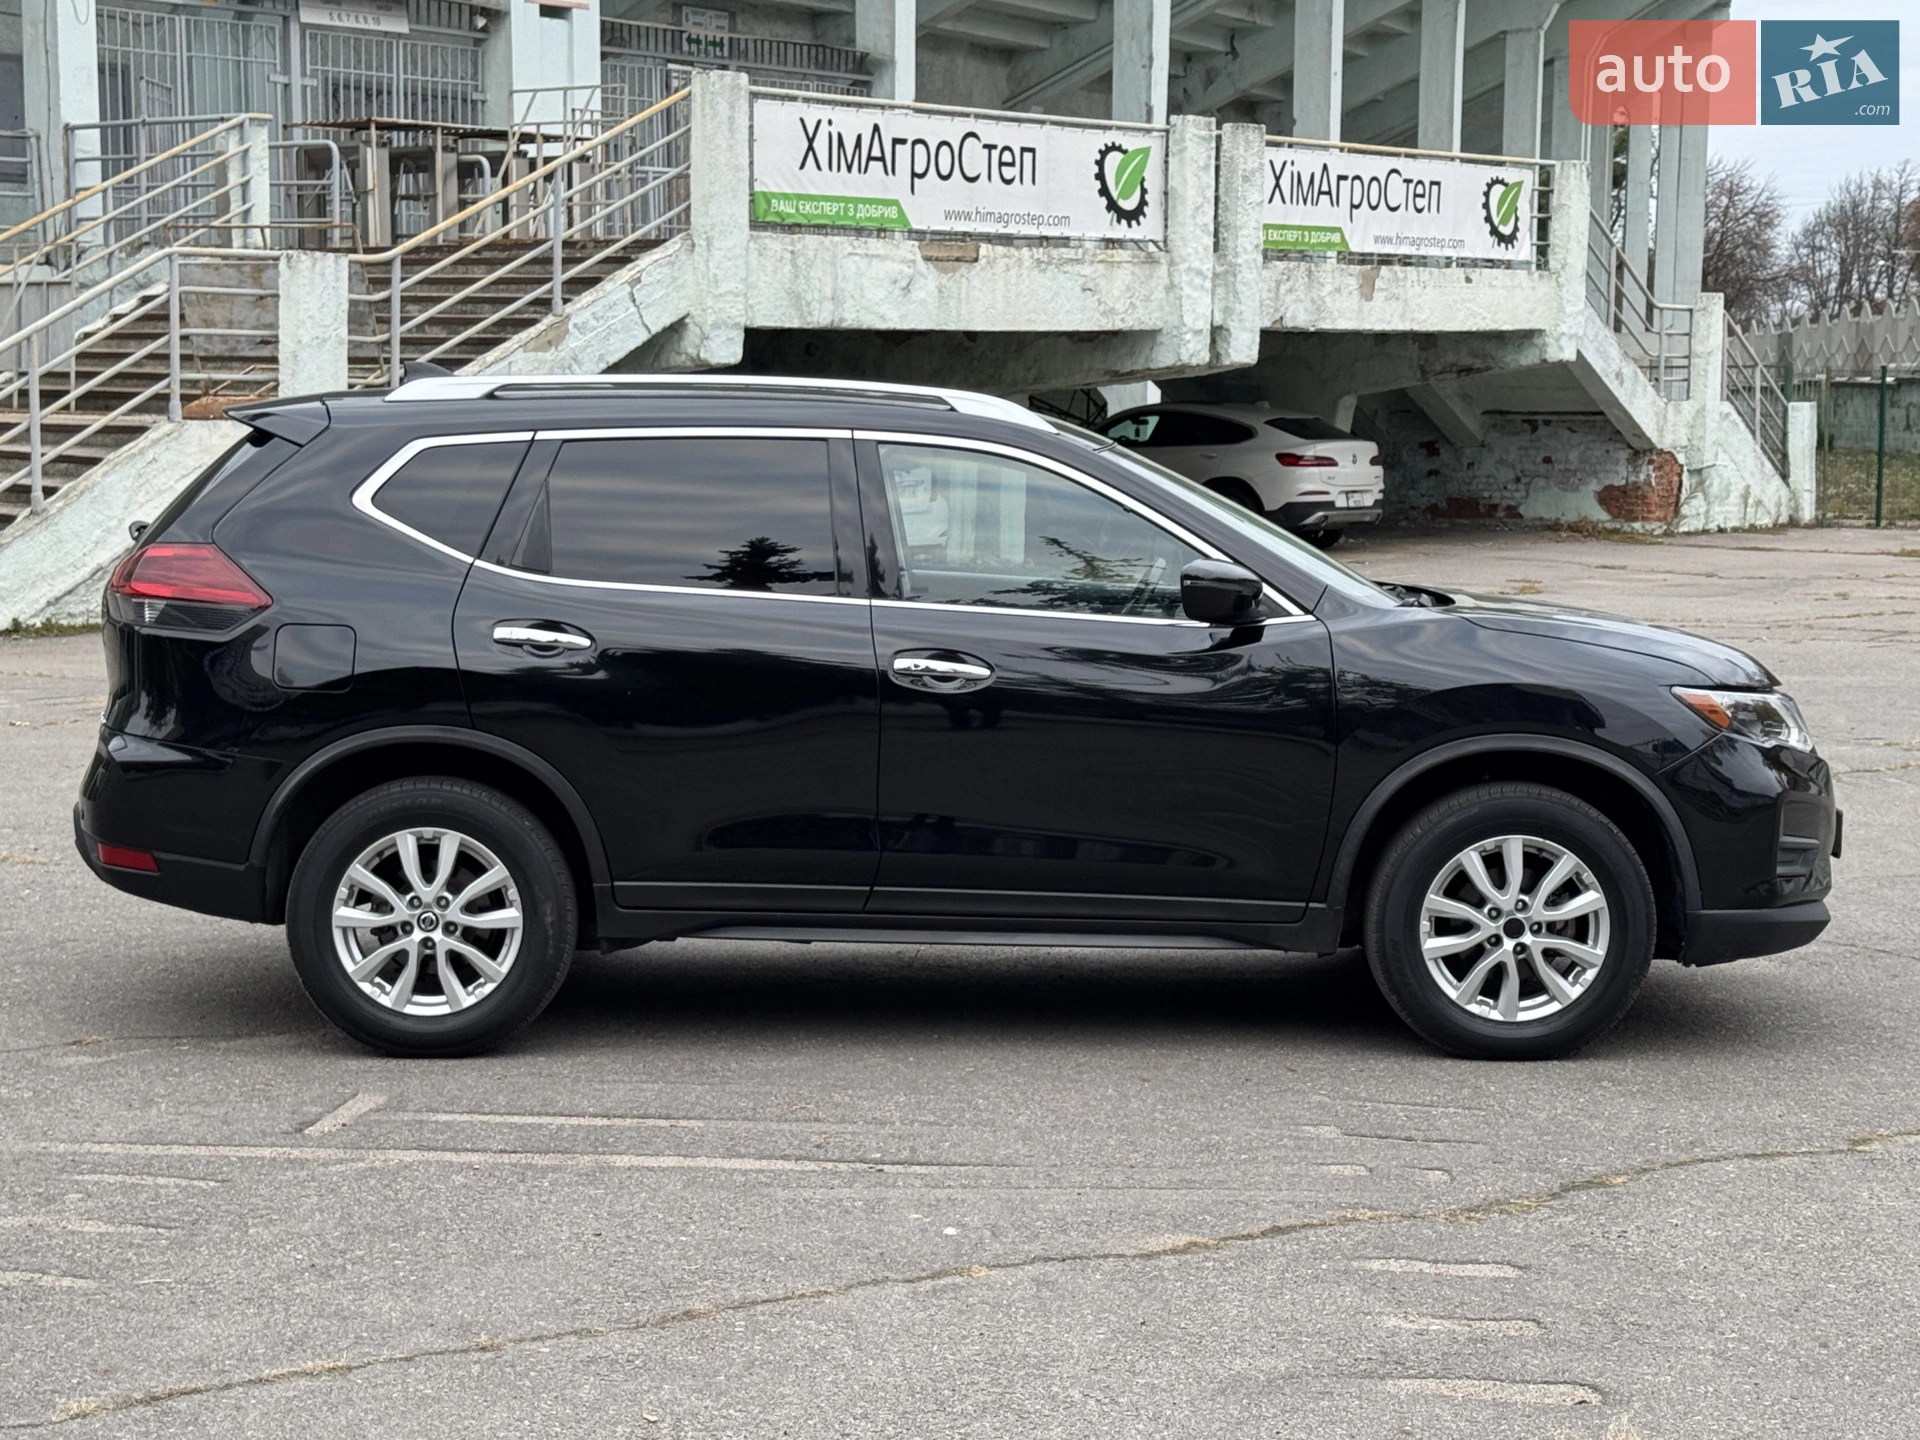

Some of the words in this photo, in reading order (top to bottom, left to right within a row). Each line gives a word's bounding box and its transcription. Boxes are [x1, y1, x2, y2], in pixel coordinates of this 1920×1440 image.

[798, 117, 1037, 195] ХімАгроСтеп
[1268, 159, 1442, 223] ХімАгроСтеп
[770, 198, 797, 214] ВАШ
[799, 200, 846, 217] ЕКСПЕРТ
[856, 204, 898, 219] ДОБРИВ
[944, 206, 1071, 229] www.himagrostep.com
[1268, 229, 1303, 242] ЕКСПЕРТ
[1310, 231, 1342, 244] ДОБРИВ
[1373, 232, 1466, 250] www.himagrostep.com
